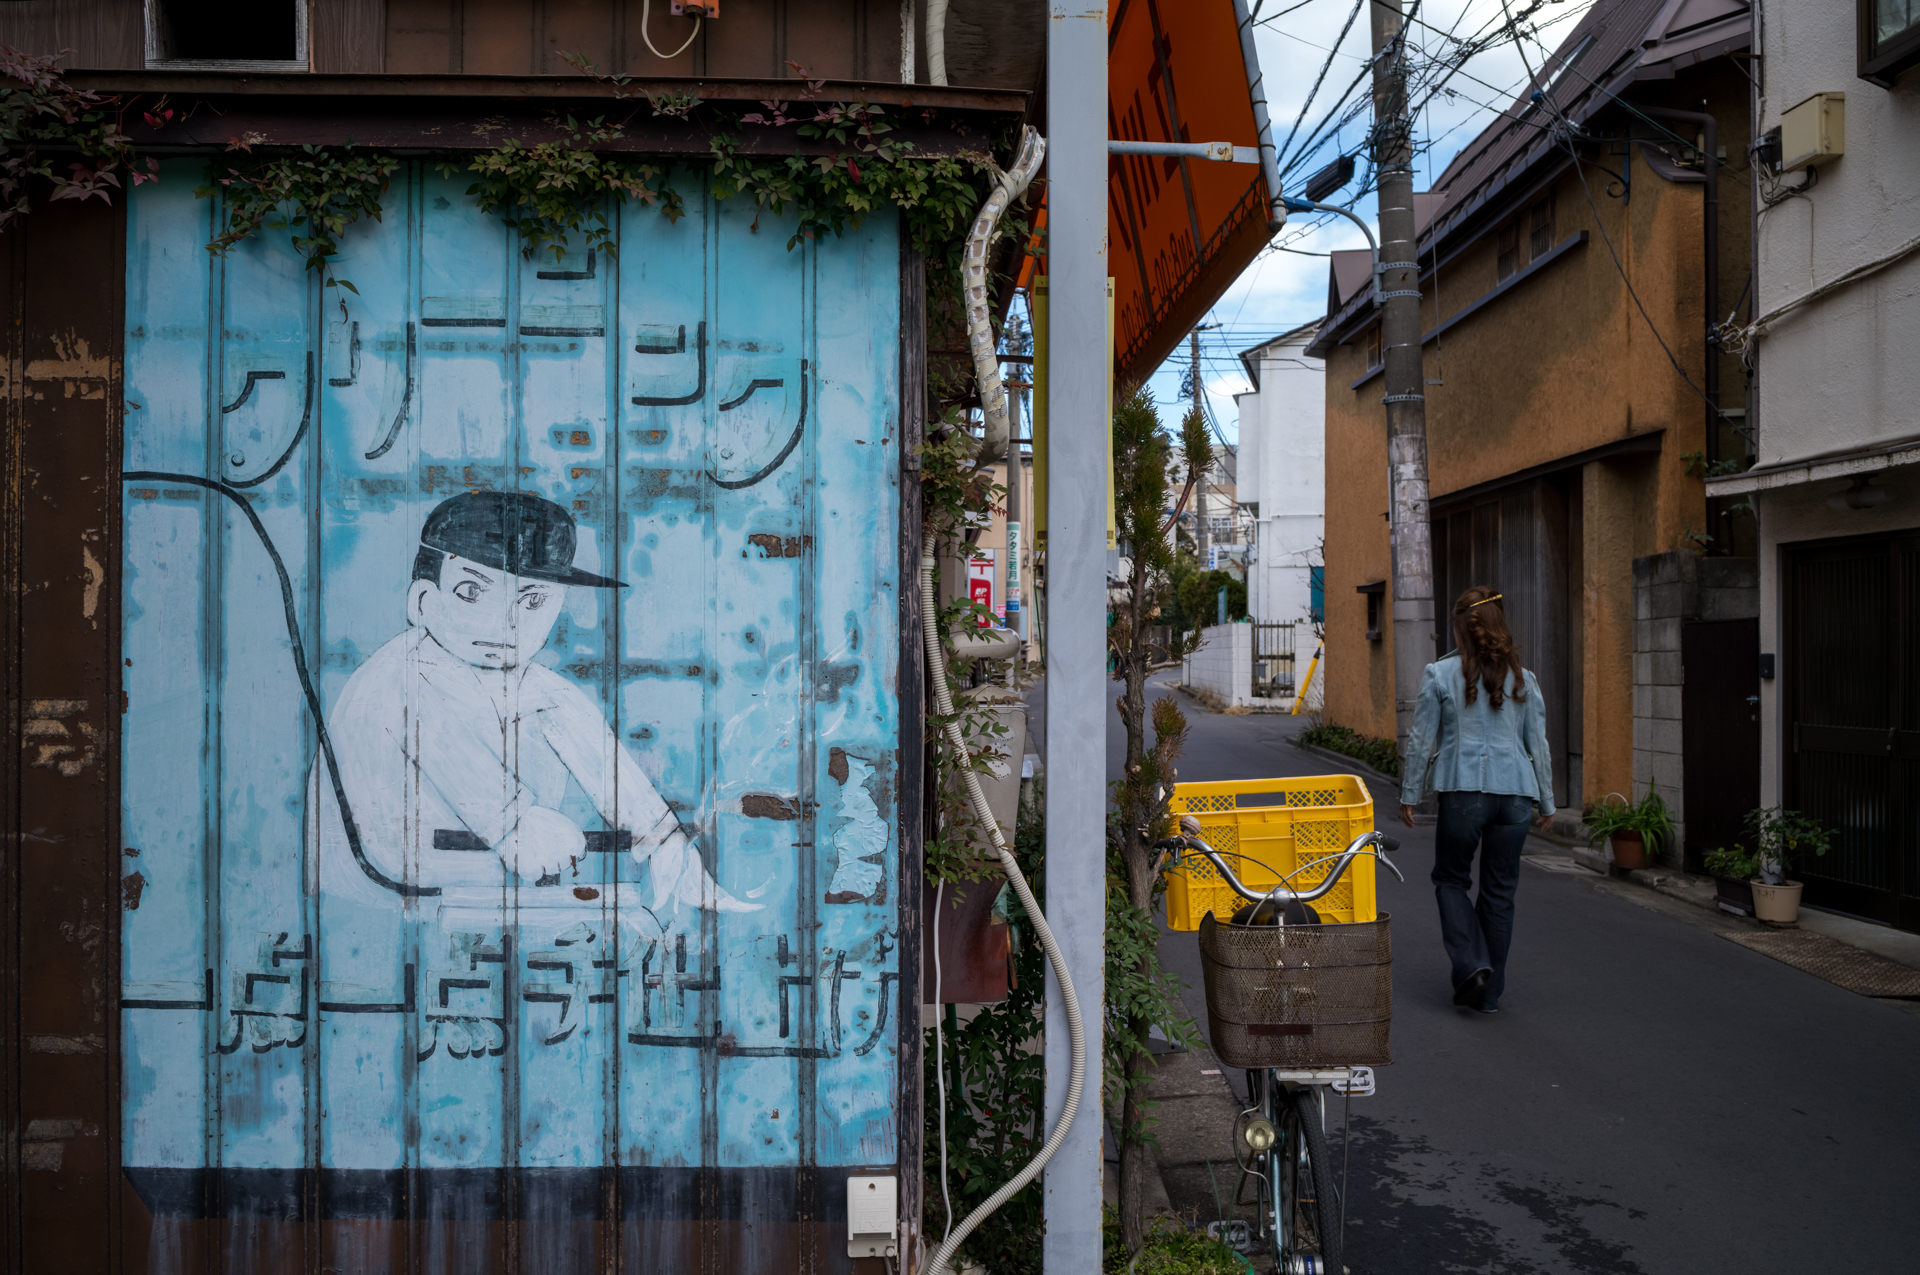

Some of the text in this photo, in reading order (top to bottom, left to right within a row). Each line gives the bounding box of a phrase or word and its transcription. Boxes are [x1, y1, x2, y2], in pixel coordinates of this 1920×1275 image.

[1008, 531, 1018, 581] タタミ若月
